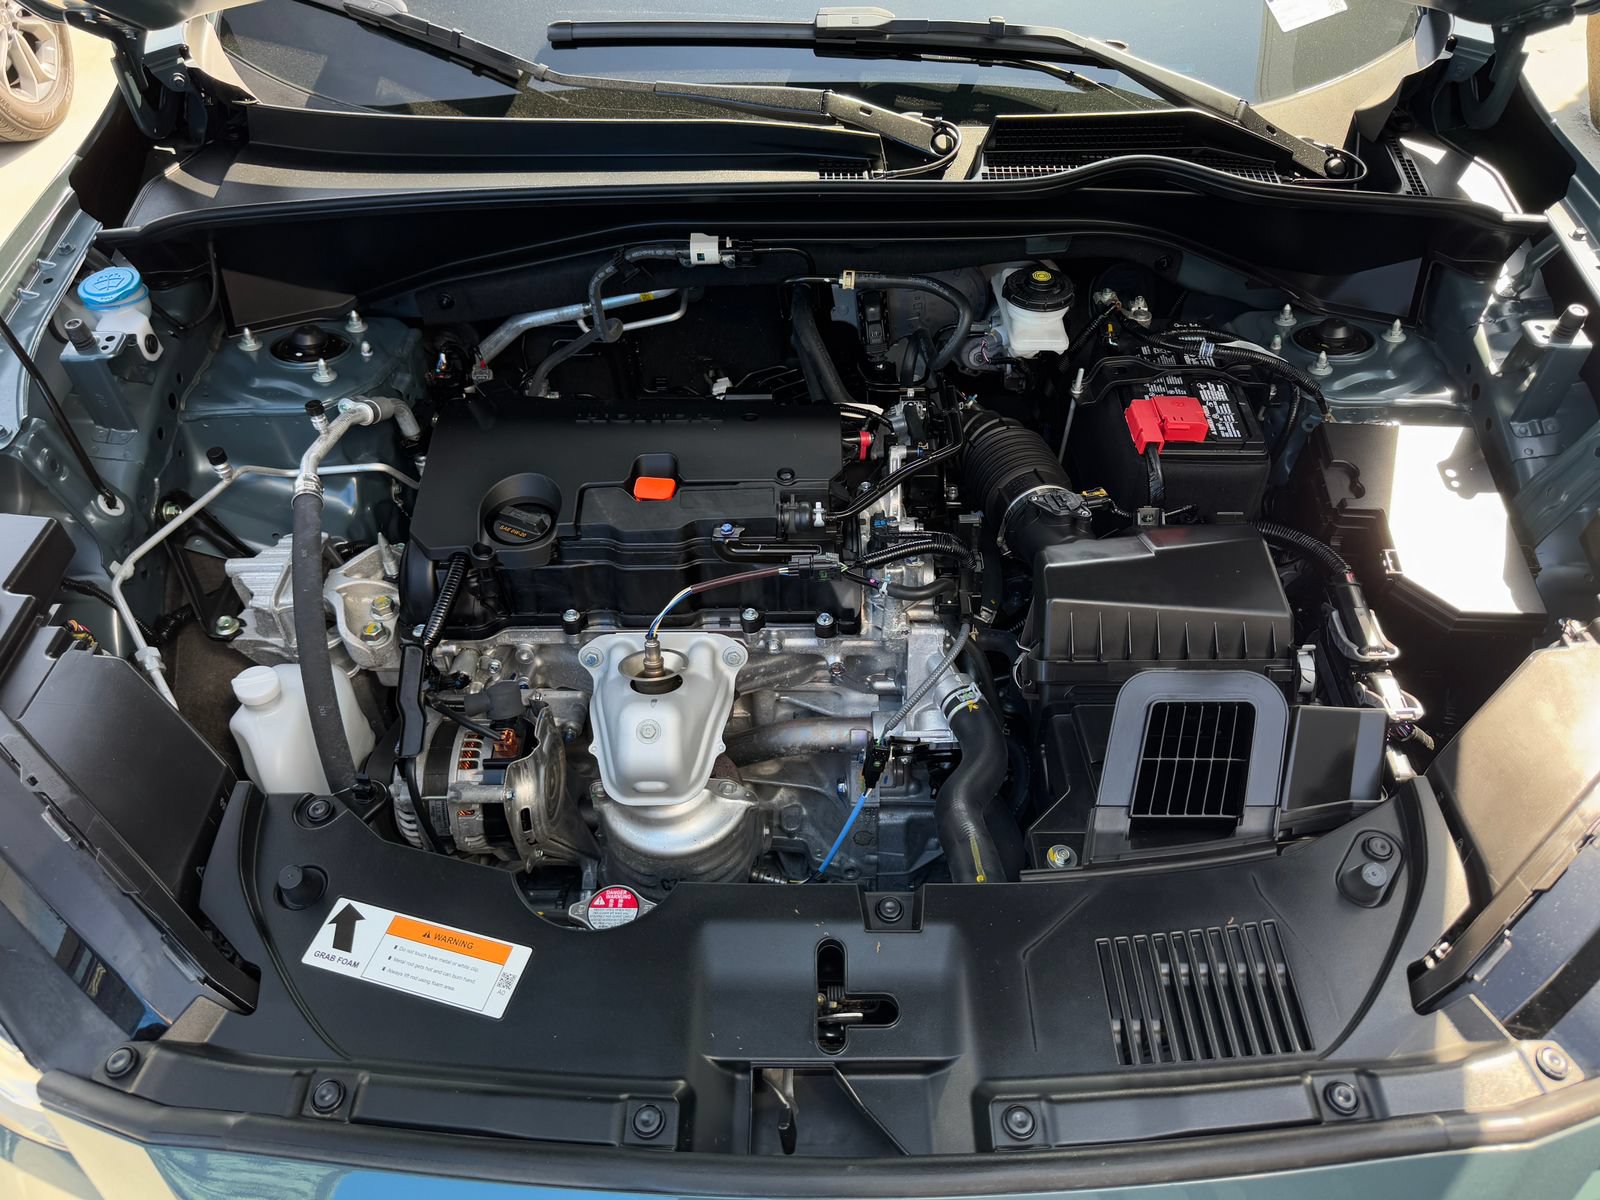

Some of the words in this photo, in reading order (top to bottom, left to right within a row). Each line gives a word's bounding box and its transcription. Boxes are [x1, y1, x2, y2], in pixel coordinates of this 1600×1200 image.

[499, 524, 513, 532] SAE
[510, 529, 528, 538] 0W-20
[434, 932, 474, 949] WARNING
[313, 949, 336, 961] GRAB
[337, 956, 360, 968] FOAM
[418, 976, 431, 985] using
